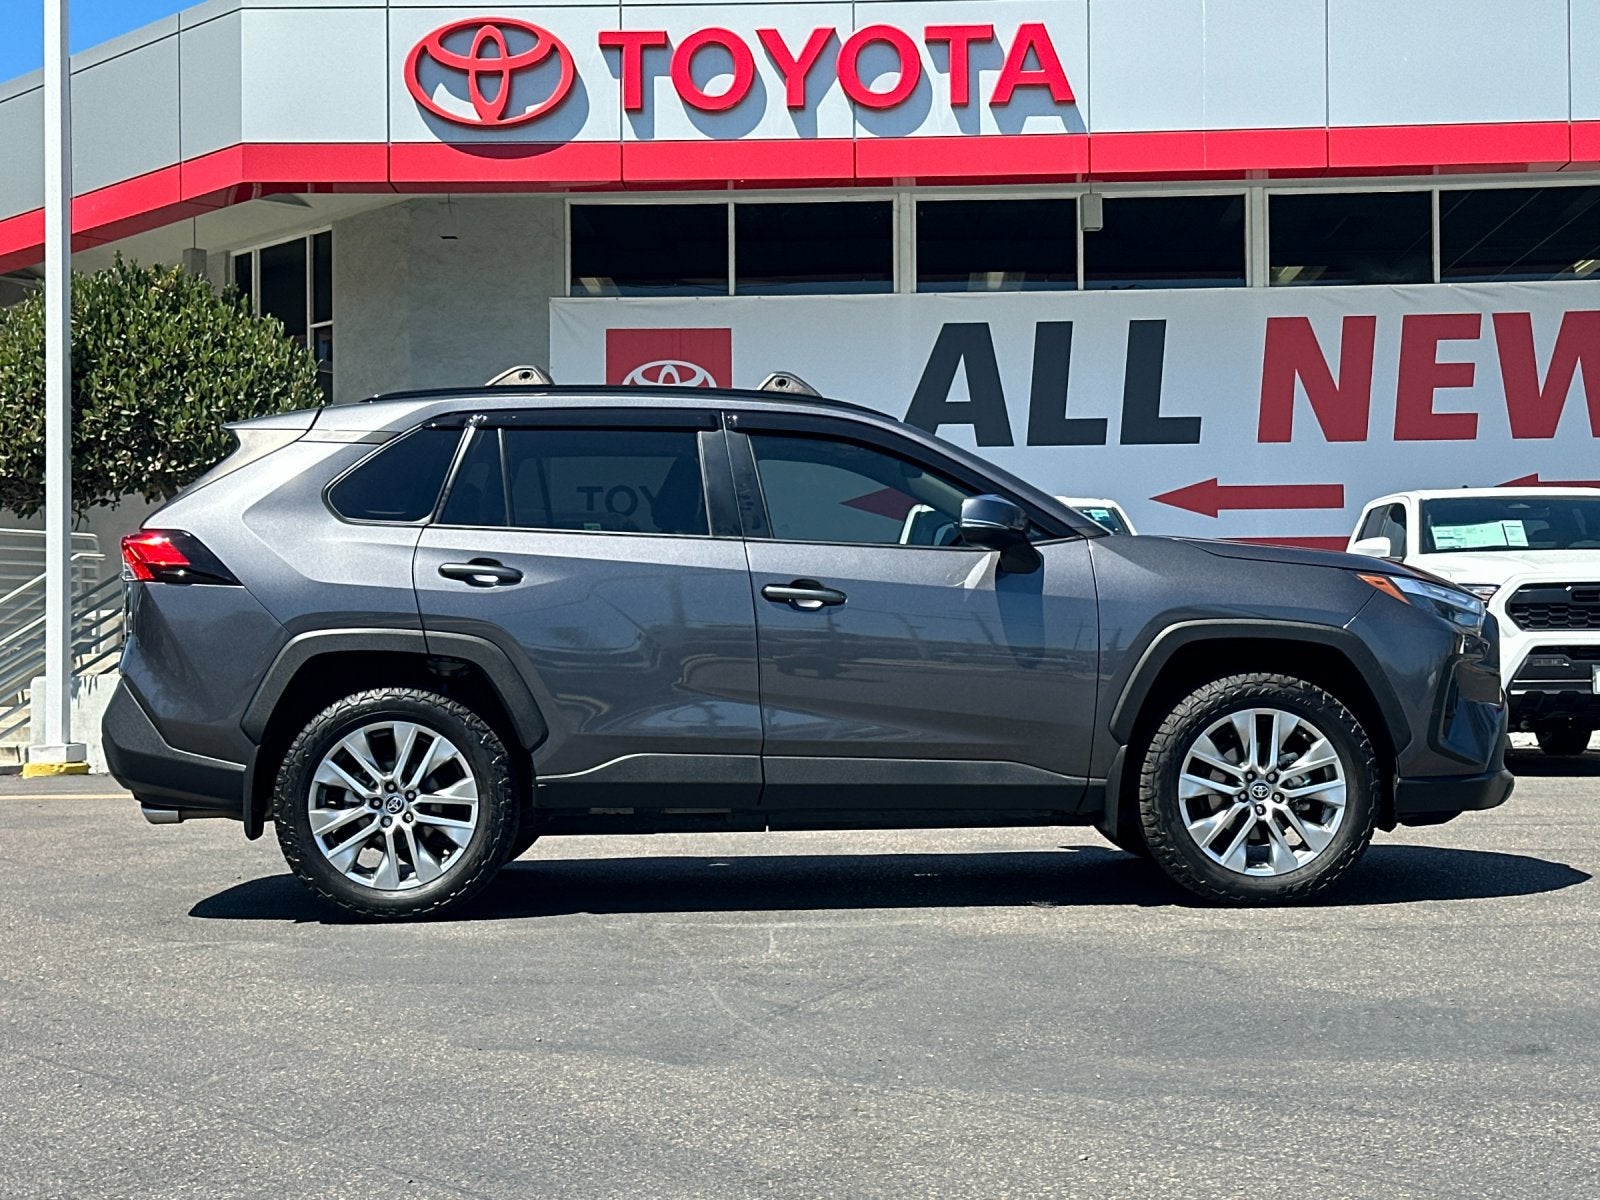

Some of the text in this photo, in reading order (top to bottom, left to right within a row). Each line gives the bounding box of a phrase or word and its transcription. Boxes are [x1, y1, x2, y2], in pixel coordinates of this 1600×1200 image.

[599, 22, 1075, 112] TOYOTA
[902, 310, 1600, 447] ALL NEW
